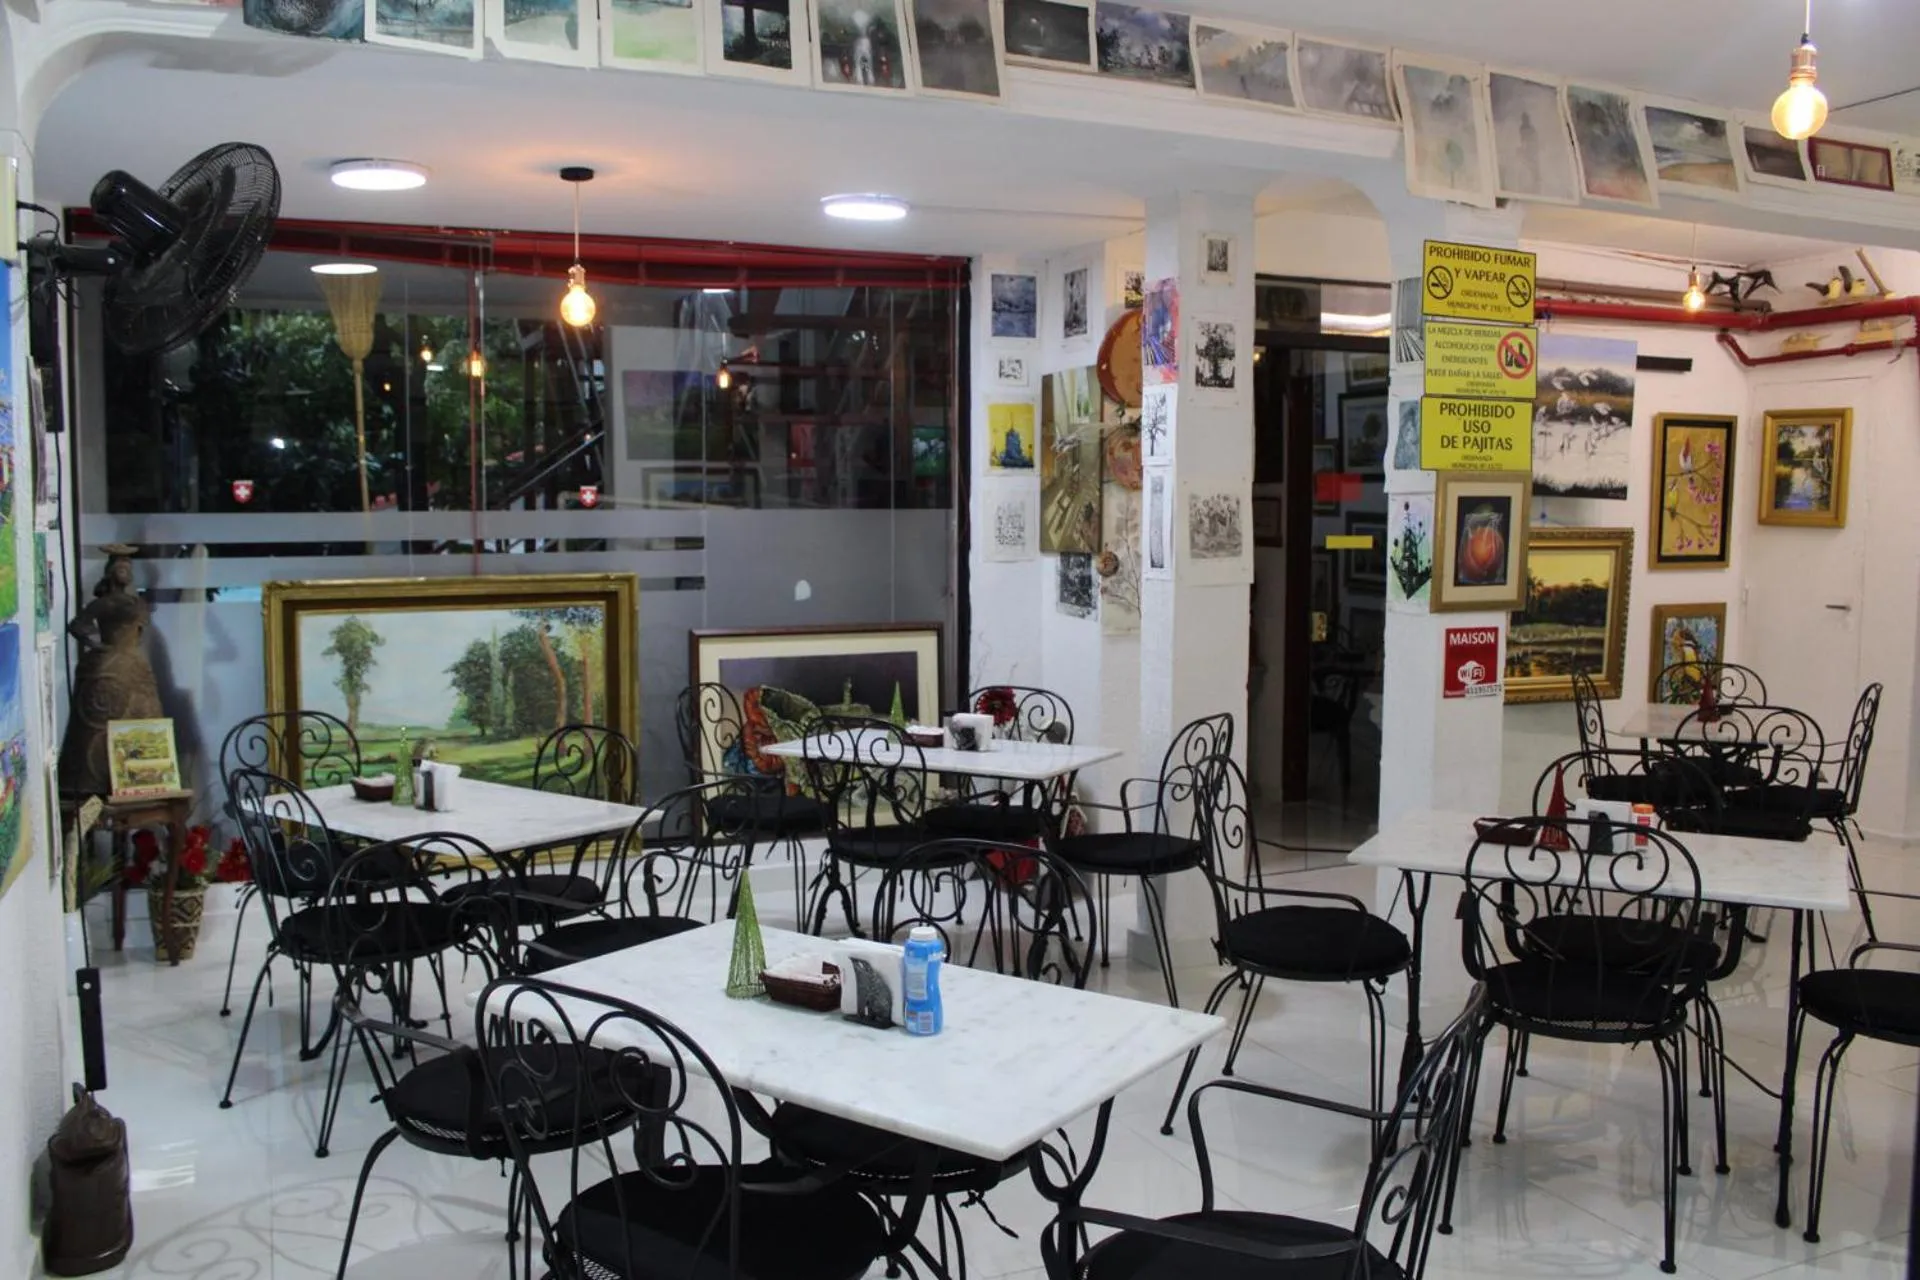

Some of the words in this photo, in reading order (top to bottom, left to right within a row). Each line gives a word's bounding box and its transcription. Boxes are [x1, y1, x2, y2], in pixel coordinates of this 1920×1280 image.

[1429, 245, 1491, 264] PROHIBIDO
[1494, 255, 1531, 268] FUMAR
[1454, 267, 1461, 278] Y
[1464, 269, 1506, 283] VAPEAR
[1427, 326, 1436, 334] LA
[1437, 327, 1463, 335] MEZCLA
[1439, 402, 1515, 419] PROHIBIDO
[1463, 420, 1491, 433] USO
[1440, 435, 1458, 448] DE
[1463, 436, 1513, 453] PAJITAS
[1449, 631, 1496, 646] MAISON
